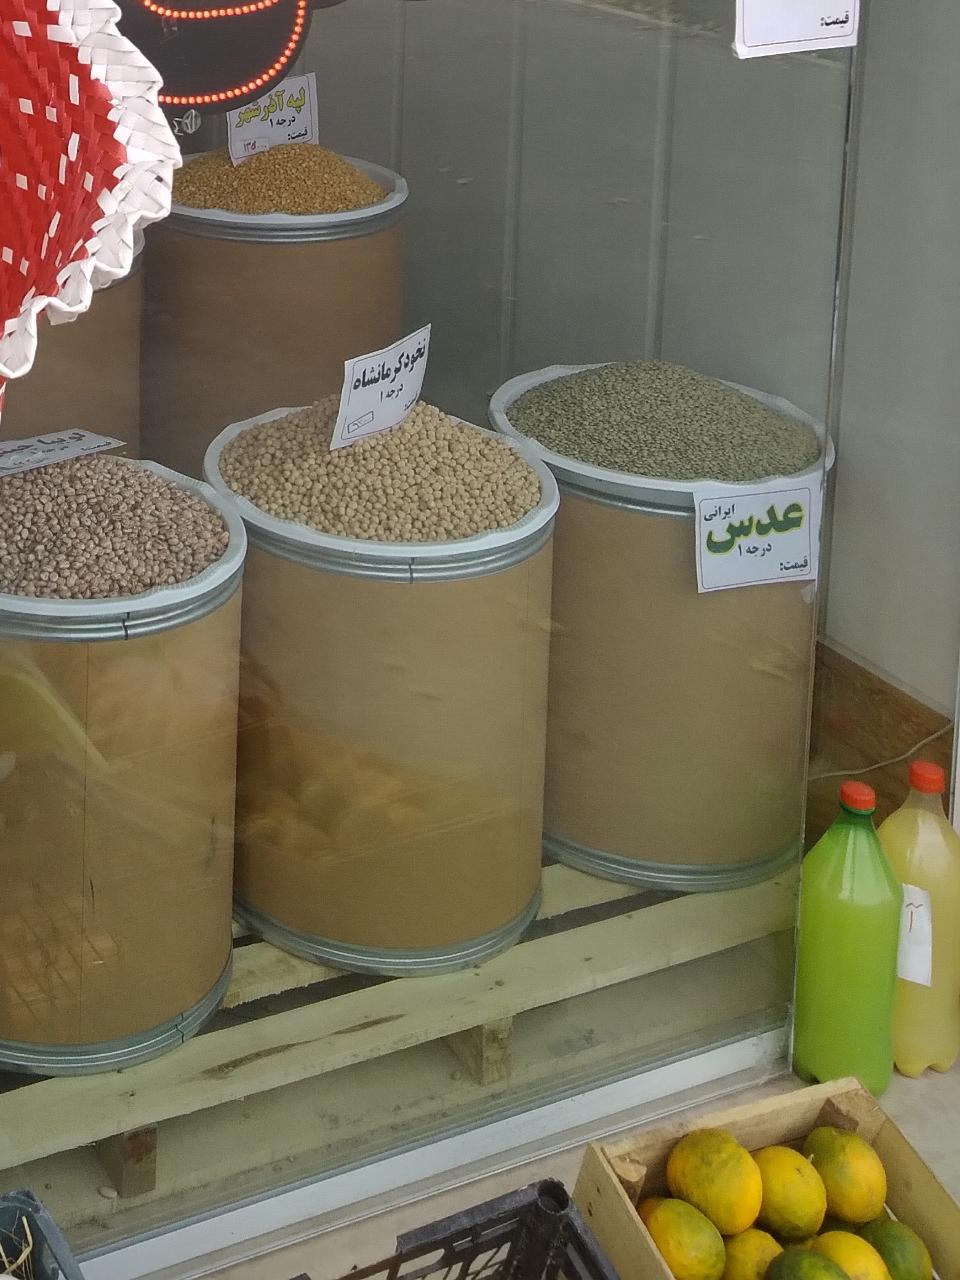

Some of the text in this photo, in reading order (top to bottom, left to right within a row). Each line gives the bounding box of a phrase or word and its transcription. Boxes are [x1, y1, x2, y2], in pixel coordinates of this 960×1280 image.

[287, 86, 306, 115] لپه
[276, 115, 297, 127] درجه
[404, 338, 427, 373] نخود
[704, 501, 805, 556] ایرانی عدس
[746, 543, 772, 558] درجه
